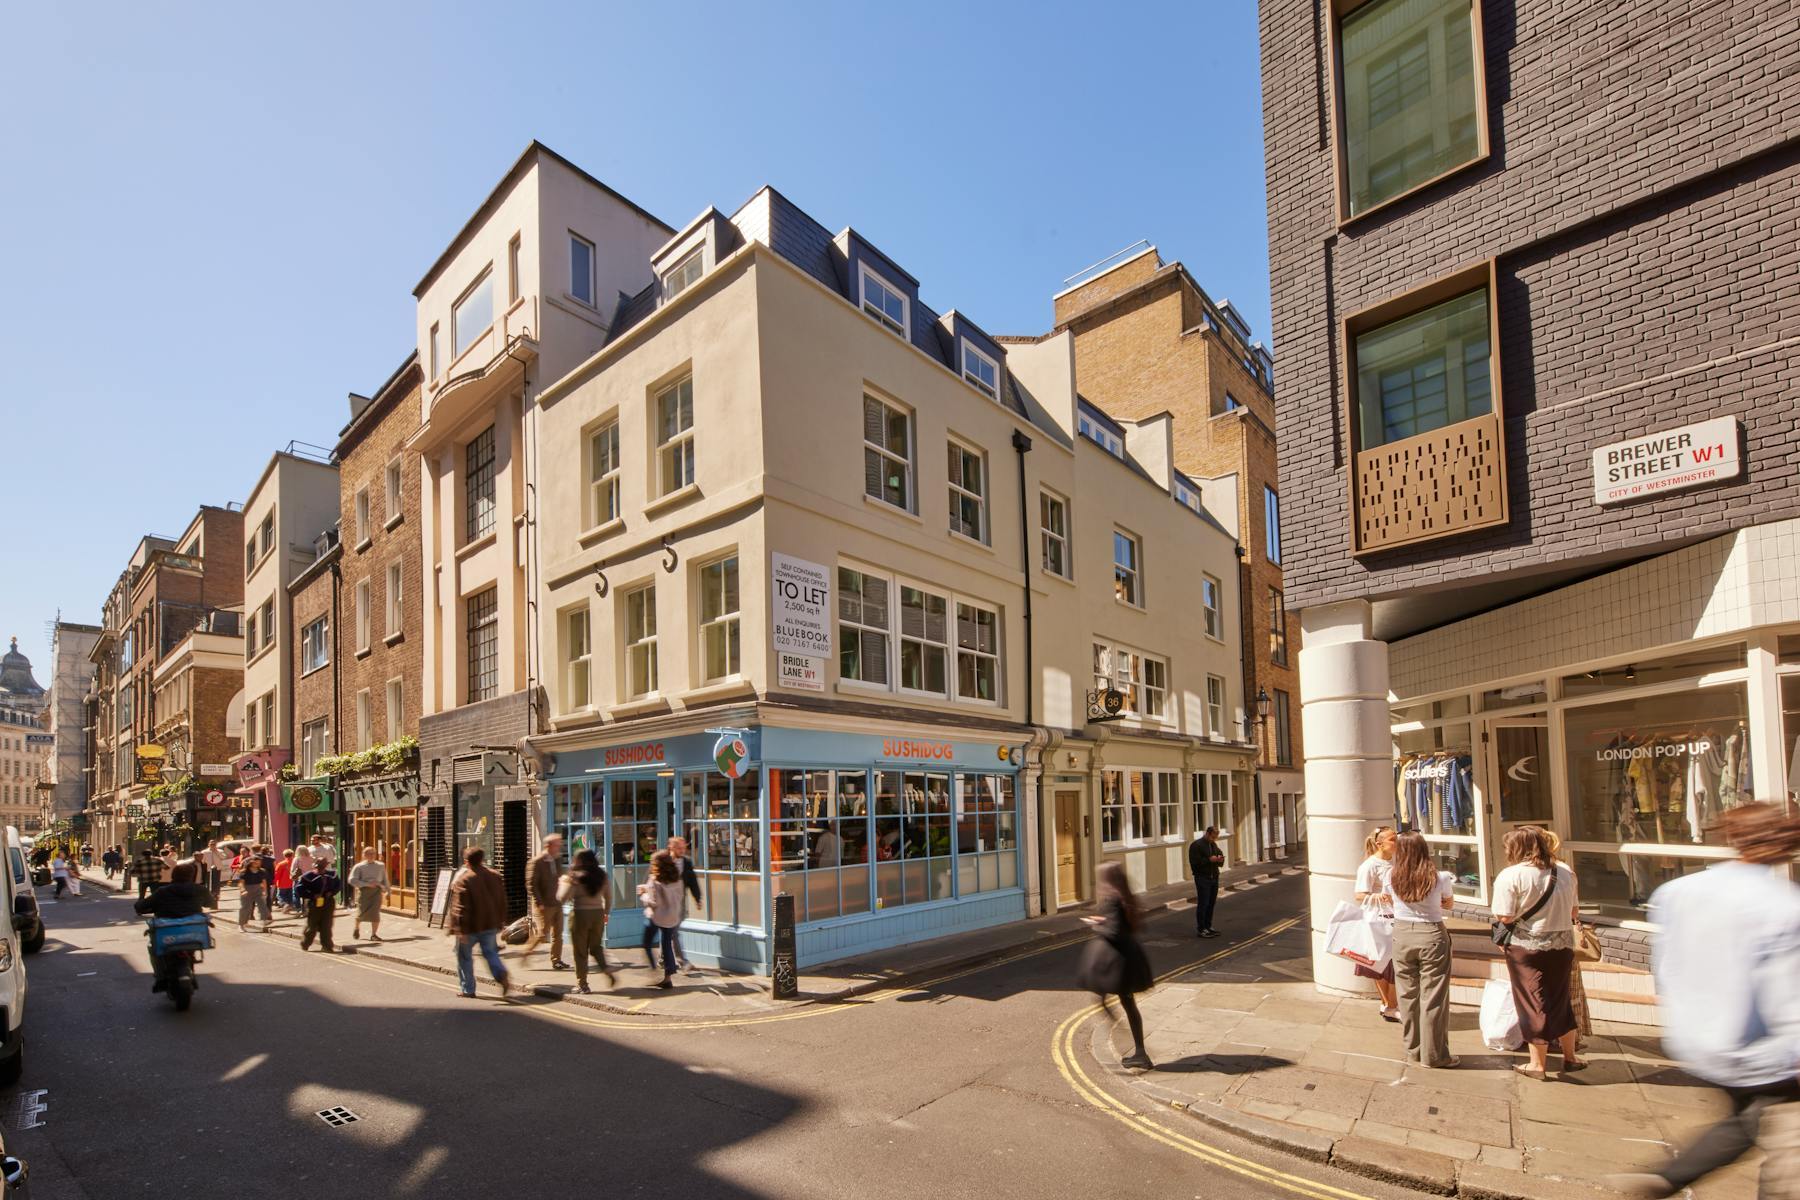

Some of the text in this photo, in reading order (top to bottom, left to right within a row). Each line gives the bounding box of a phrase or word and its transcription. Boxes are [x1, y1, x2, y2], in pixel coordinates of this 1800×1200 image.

[1608, 433, 1692, 466] BREWER
[1609, 443, 1725, 483] STREET W1
[1609, 469, 1716, 499] CITY OF WESTMINSTER
[775, 569, 810, 585] TOWNHOUSE
[781, 562, 823, 579] SELF CONTAINED
[776, 579, 828, 607] TO LET
[784, 600, 821, 616] 2,500 sq ft
[785, 617, 795, 625] ALL
[776, 624, 829, 644] BLUEBOOK
[776, 636, 829, 652] 020 7167 6400
[783, 655, 809, 668] BRIDLE
[783, 666, 816, 679] LANE W1
[1108, 697, 1119, 707] 36
[604, 743, 665, 766] SUSHIDOG
[883, 738, 953, 760] SUSHIDOG
[1596, 741, 1711, 761] LONDON POP UP
[1405, 765, 1448, 780] scuffers
[227, 796, 253, 808] TH
